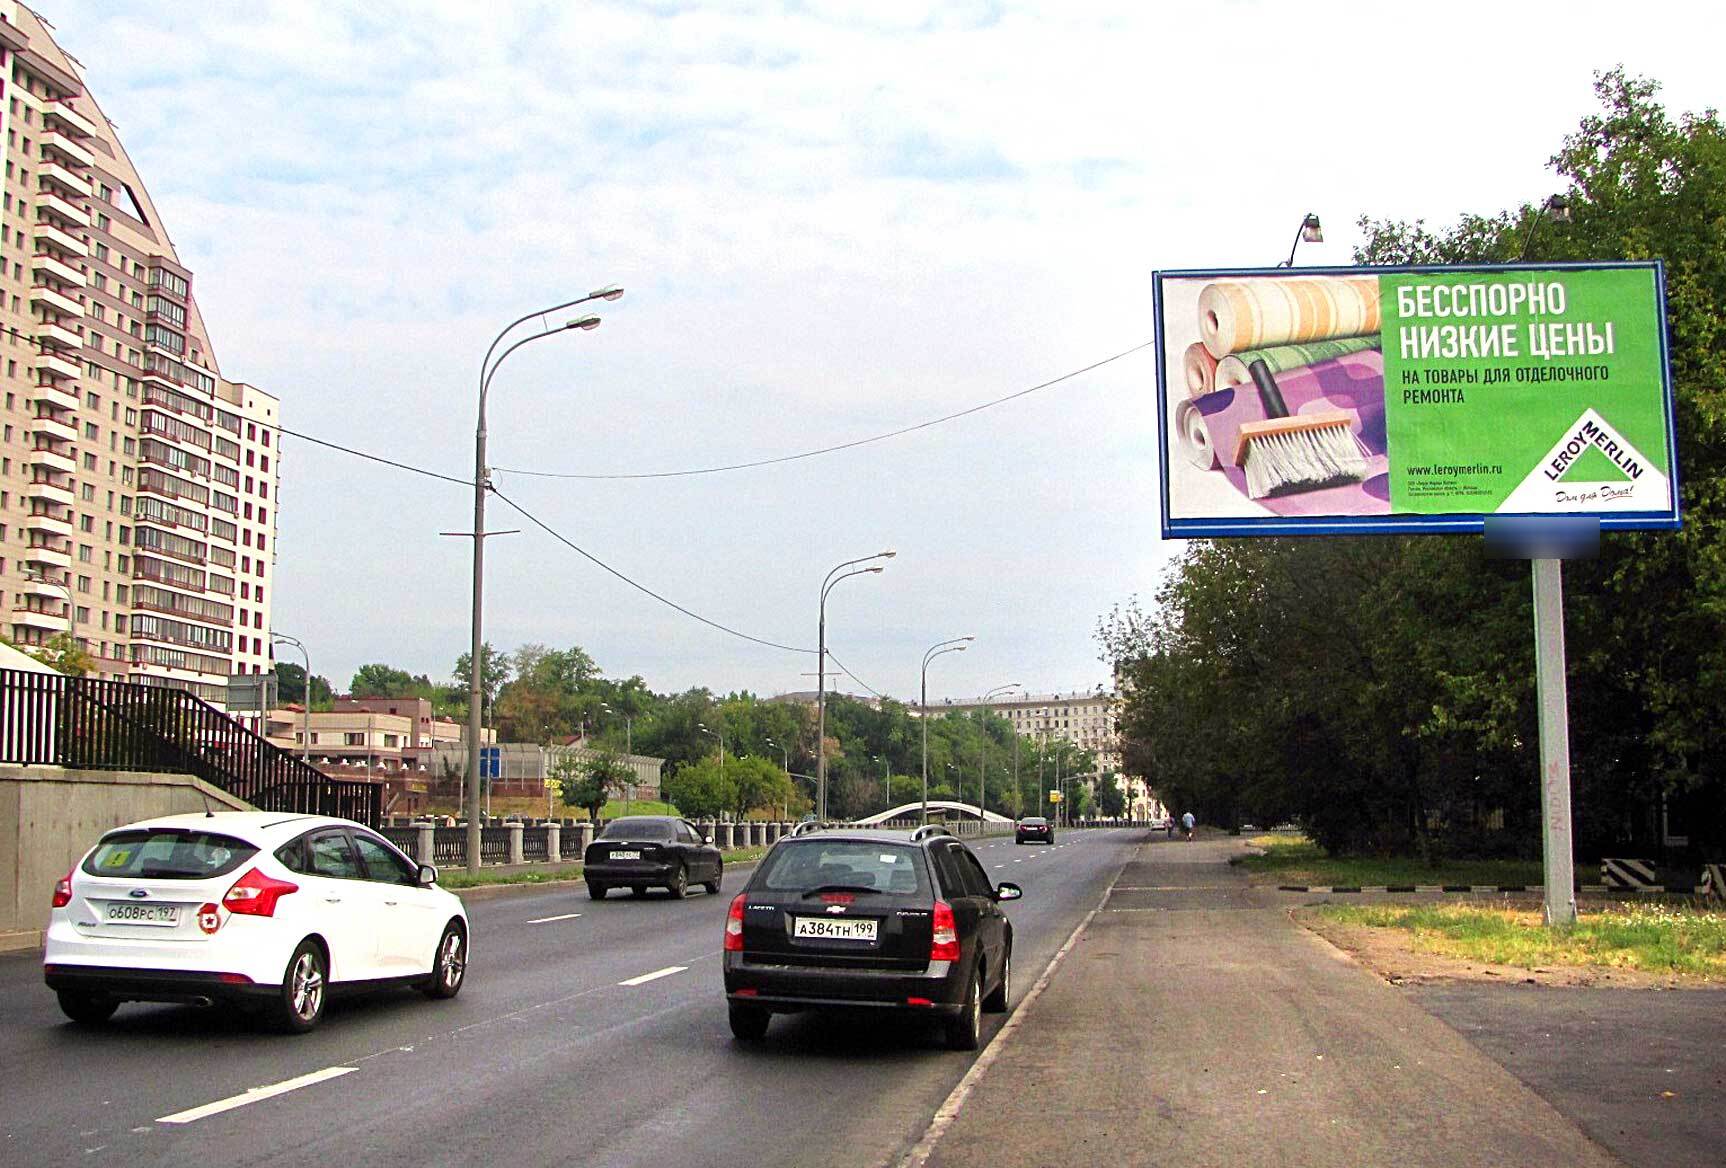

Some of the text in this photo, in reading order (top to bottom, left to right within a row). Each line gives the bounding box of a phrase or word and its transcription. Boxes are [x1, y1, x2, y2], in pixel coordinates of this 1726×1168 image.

[1397, 282, 1566, 318] БЕССПОРНО
[1399, 322, 1615, 360] НИЗКИЕ ЦЕНЫ
[1402, 365, 1609, 385] НА ТОВАРЫ ДЛЯ ОТДЕЛОЧНОГО
[1403, 388, 1465, 404] РЕМОНТА
[1544, 420, 1643, 481] LEROY MERLIN
[1407, 464, 1502, 478] www.leroymerlin.ru
[800, 921, 873, 936] А384ТН 199
